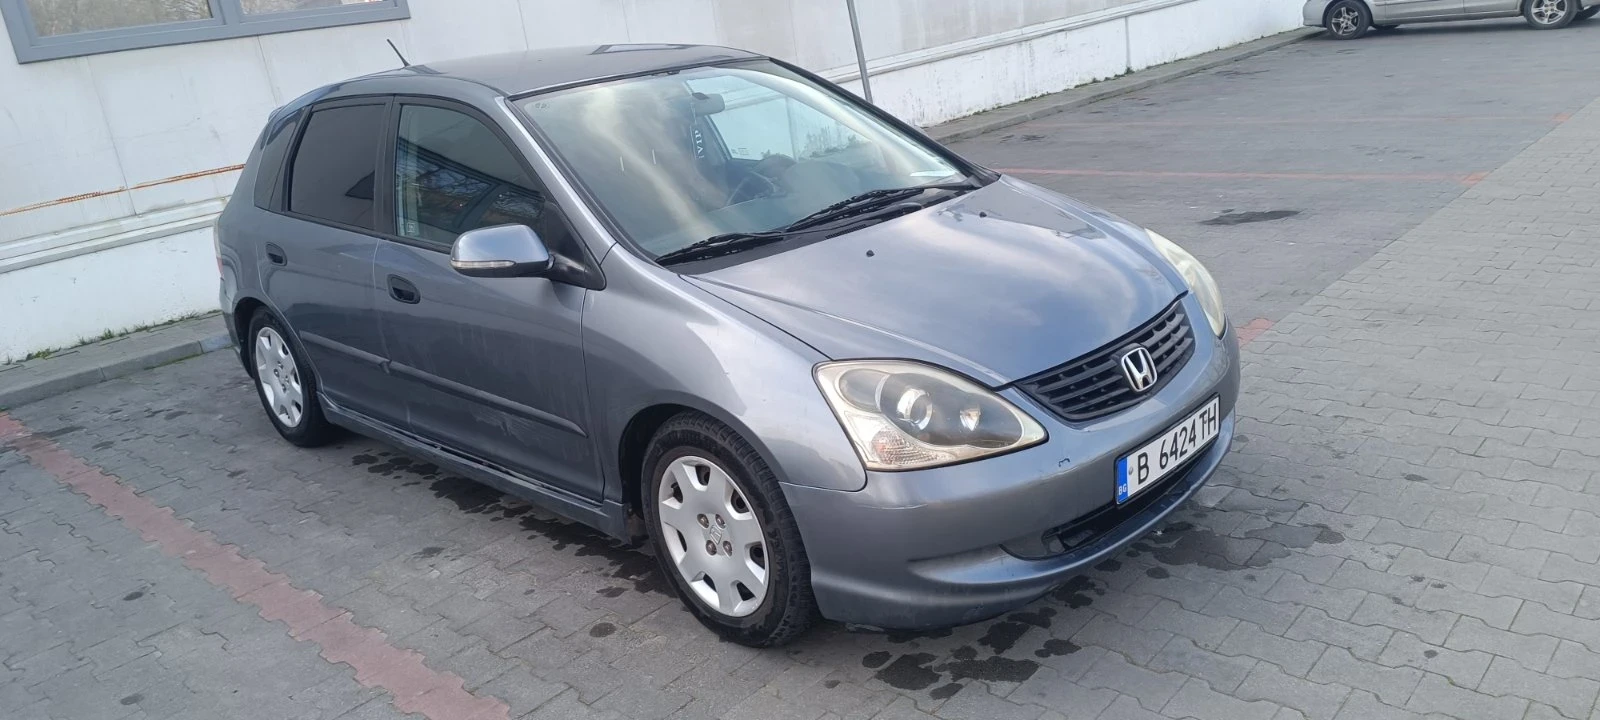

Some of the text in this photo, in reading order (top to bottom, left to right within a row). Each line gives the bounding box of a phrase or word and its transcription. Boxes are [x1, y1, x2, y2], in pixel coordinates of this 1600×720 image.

[1137, 402, 1217, 485] B 6424 TH
[1118, 483, 1127, 496] BG
